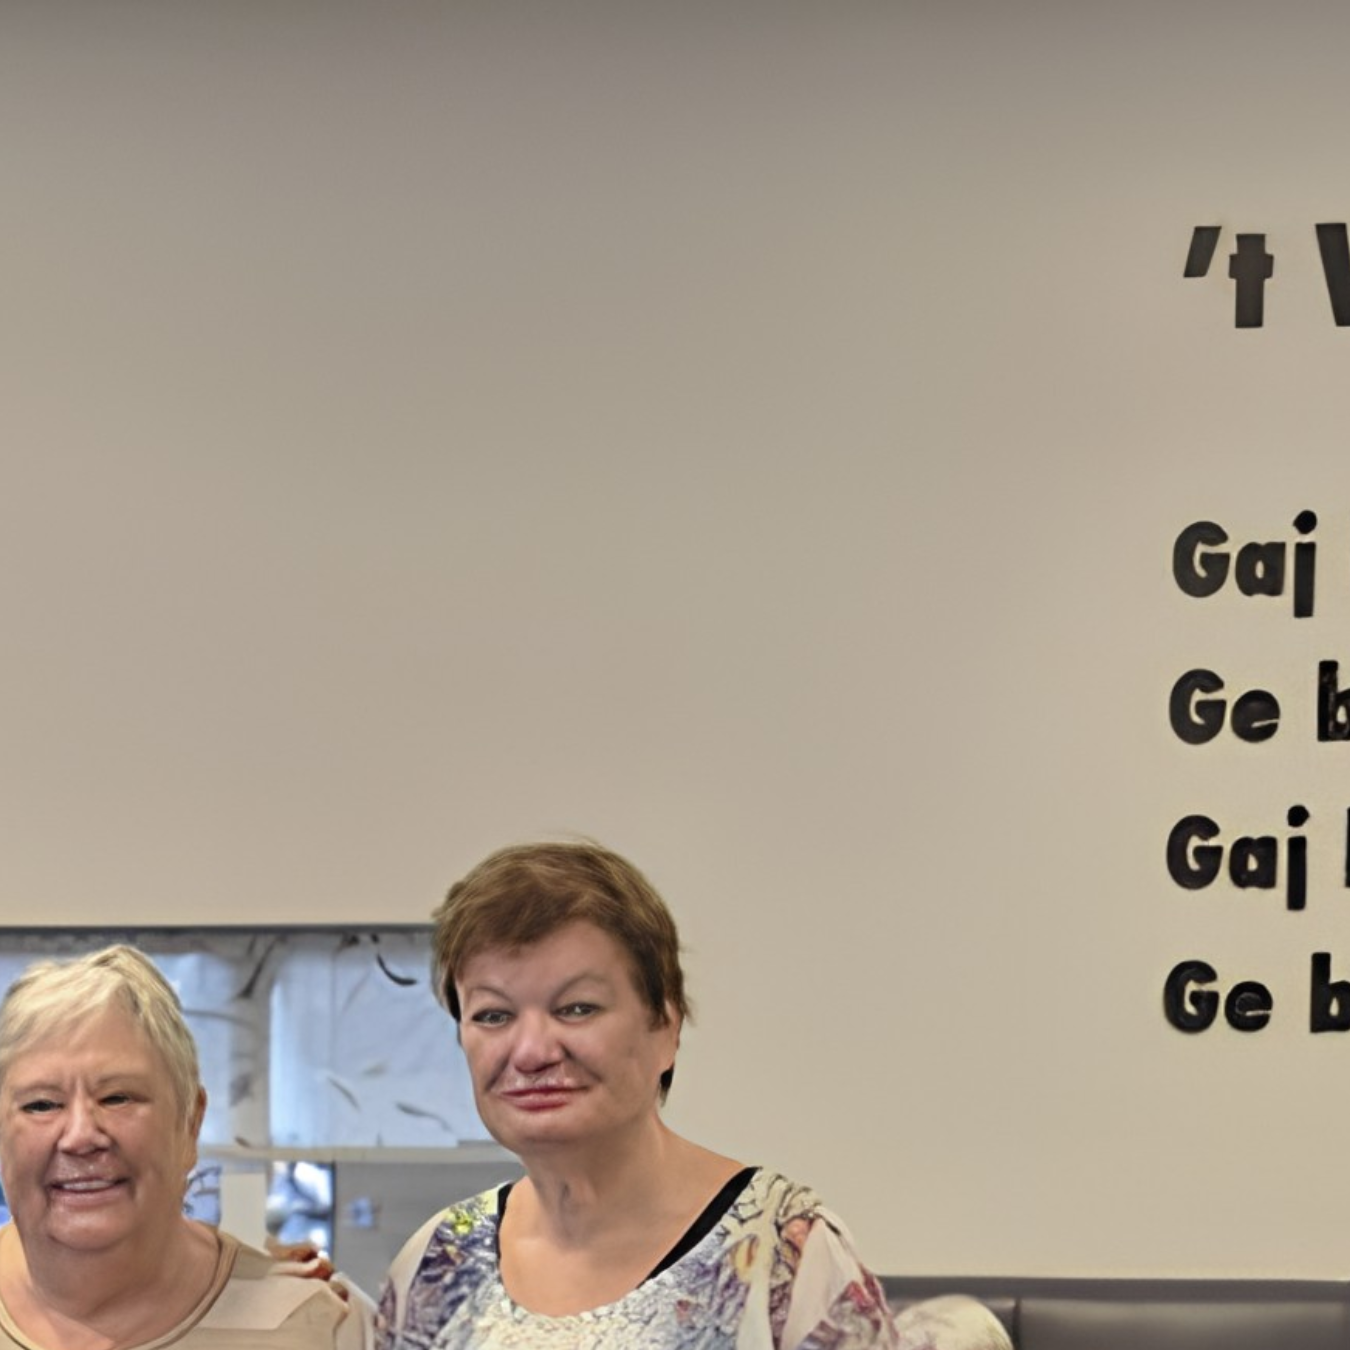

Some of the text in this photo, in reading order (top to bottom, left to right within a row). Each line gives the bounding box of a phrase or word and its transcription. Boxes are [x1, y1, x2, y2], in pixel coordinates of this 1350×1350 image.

[1183, 225, 1275, 329] 't
[1172, 509, 1318, 619] Gaj
[1169, 668, 1281, 745] Ge
[1166, 804, 1311, 912] Gaj
[1163, 959, 1274, 1035] Ge
